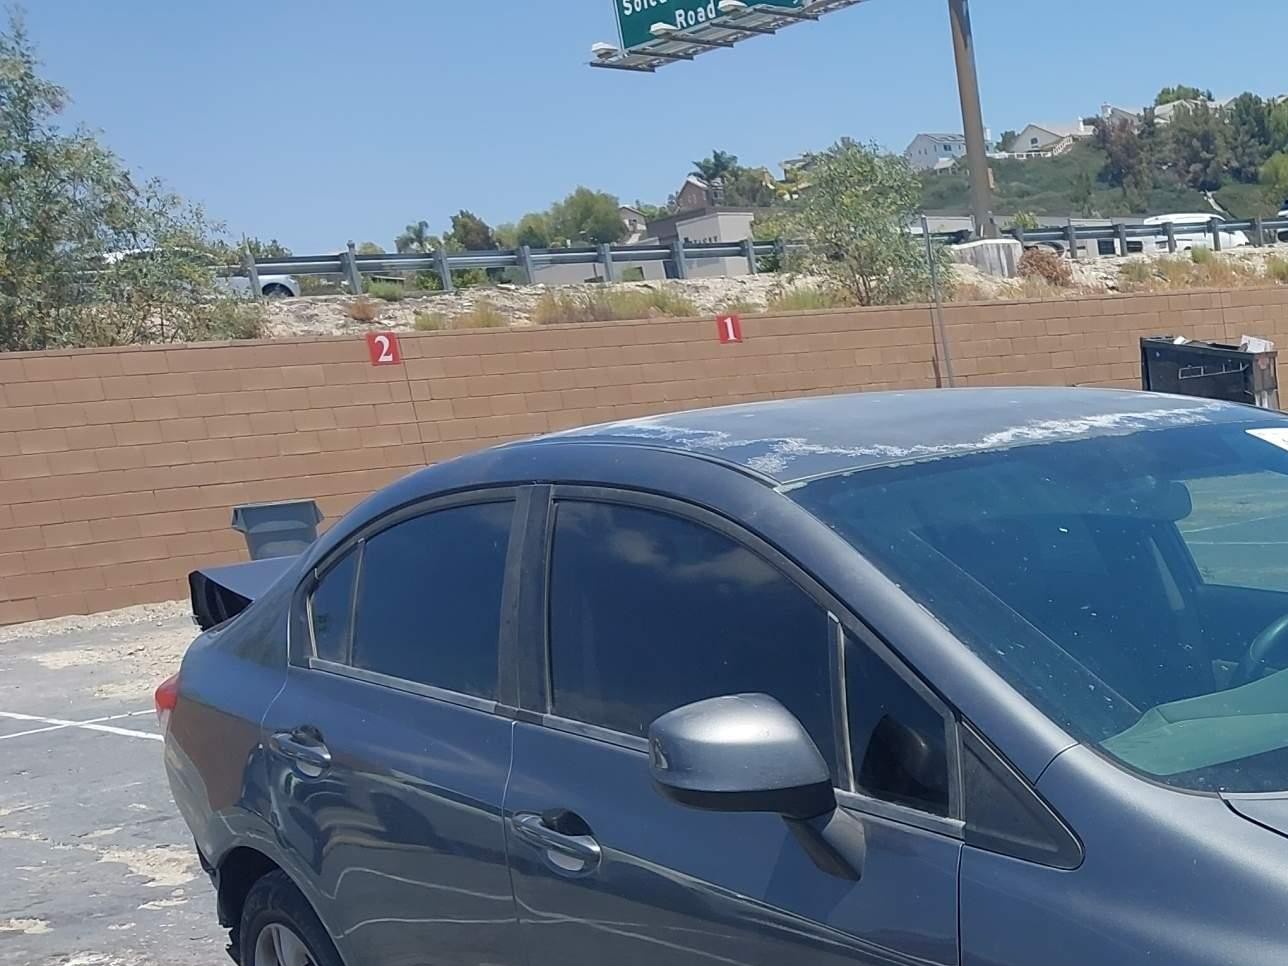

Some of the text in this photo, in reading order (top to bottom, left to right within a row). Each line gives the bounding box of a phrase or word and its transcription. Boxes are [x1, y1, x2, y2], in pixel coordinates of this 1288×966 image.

[675, 0, 717, 29] Road
[723, 317, 737, 341] 1
[374, 335, 393, 362] 2
